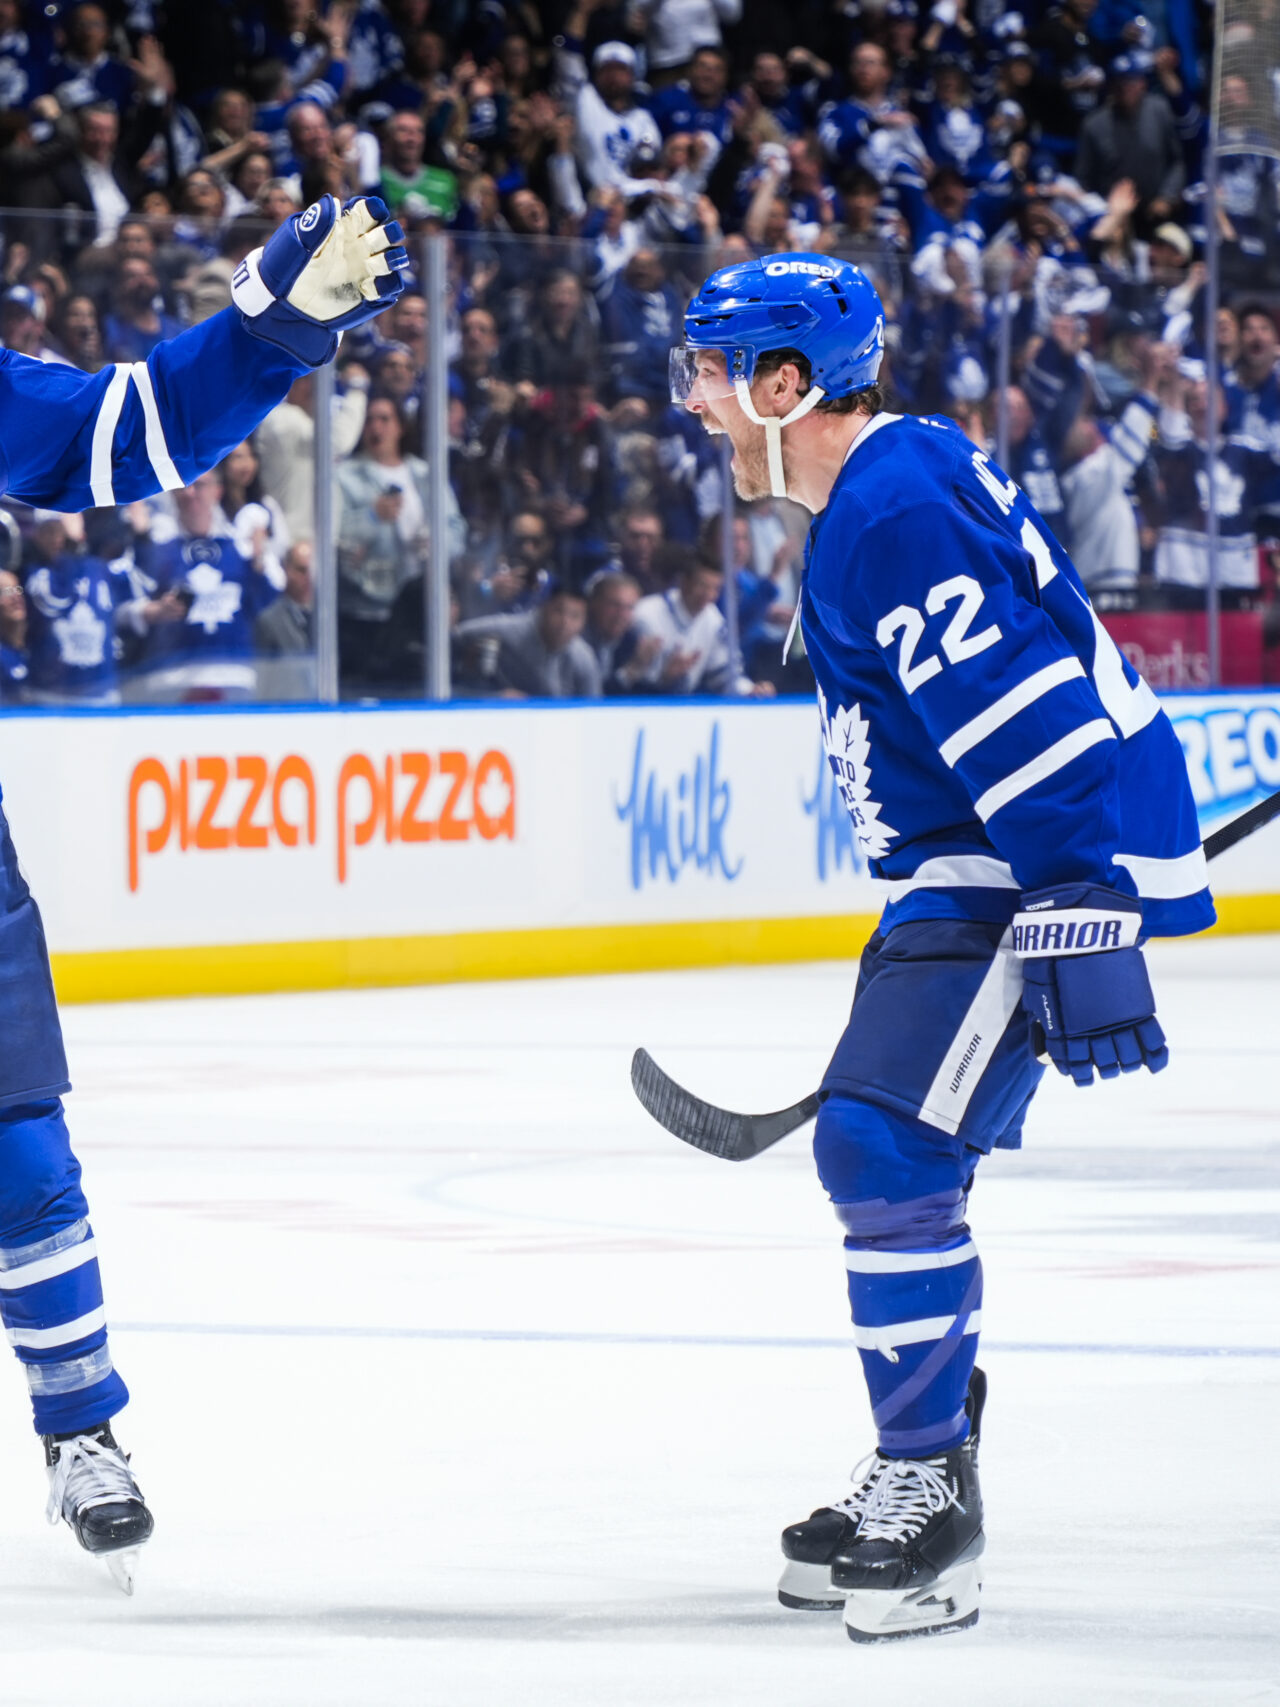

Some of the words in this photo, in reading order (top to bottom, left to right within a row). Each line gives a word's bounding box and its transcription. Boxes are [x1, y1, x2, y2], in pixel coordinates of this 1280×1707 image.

[766, 261, 834, 278] OREO
[875, 574, 1003, 695] 22
[1172, 708, 1280, 805] REO
[127, 754, 317, 894] pizza
[336, 748, 517, 885] pizza
[1013, 920, 1122, 952] ARRIOR
[949, 1033, 982, 1094] WARRIOR
